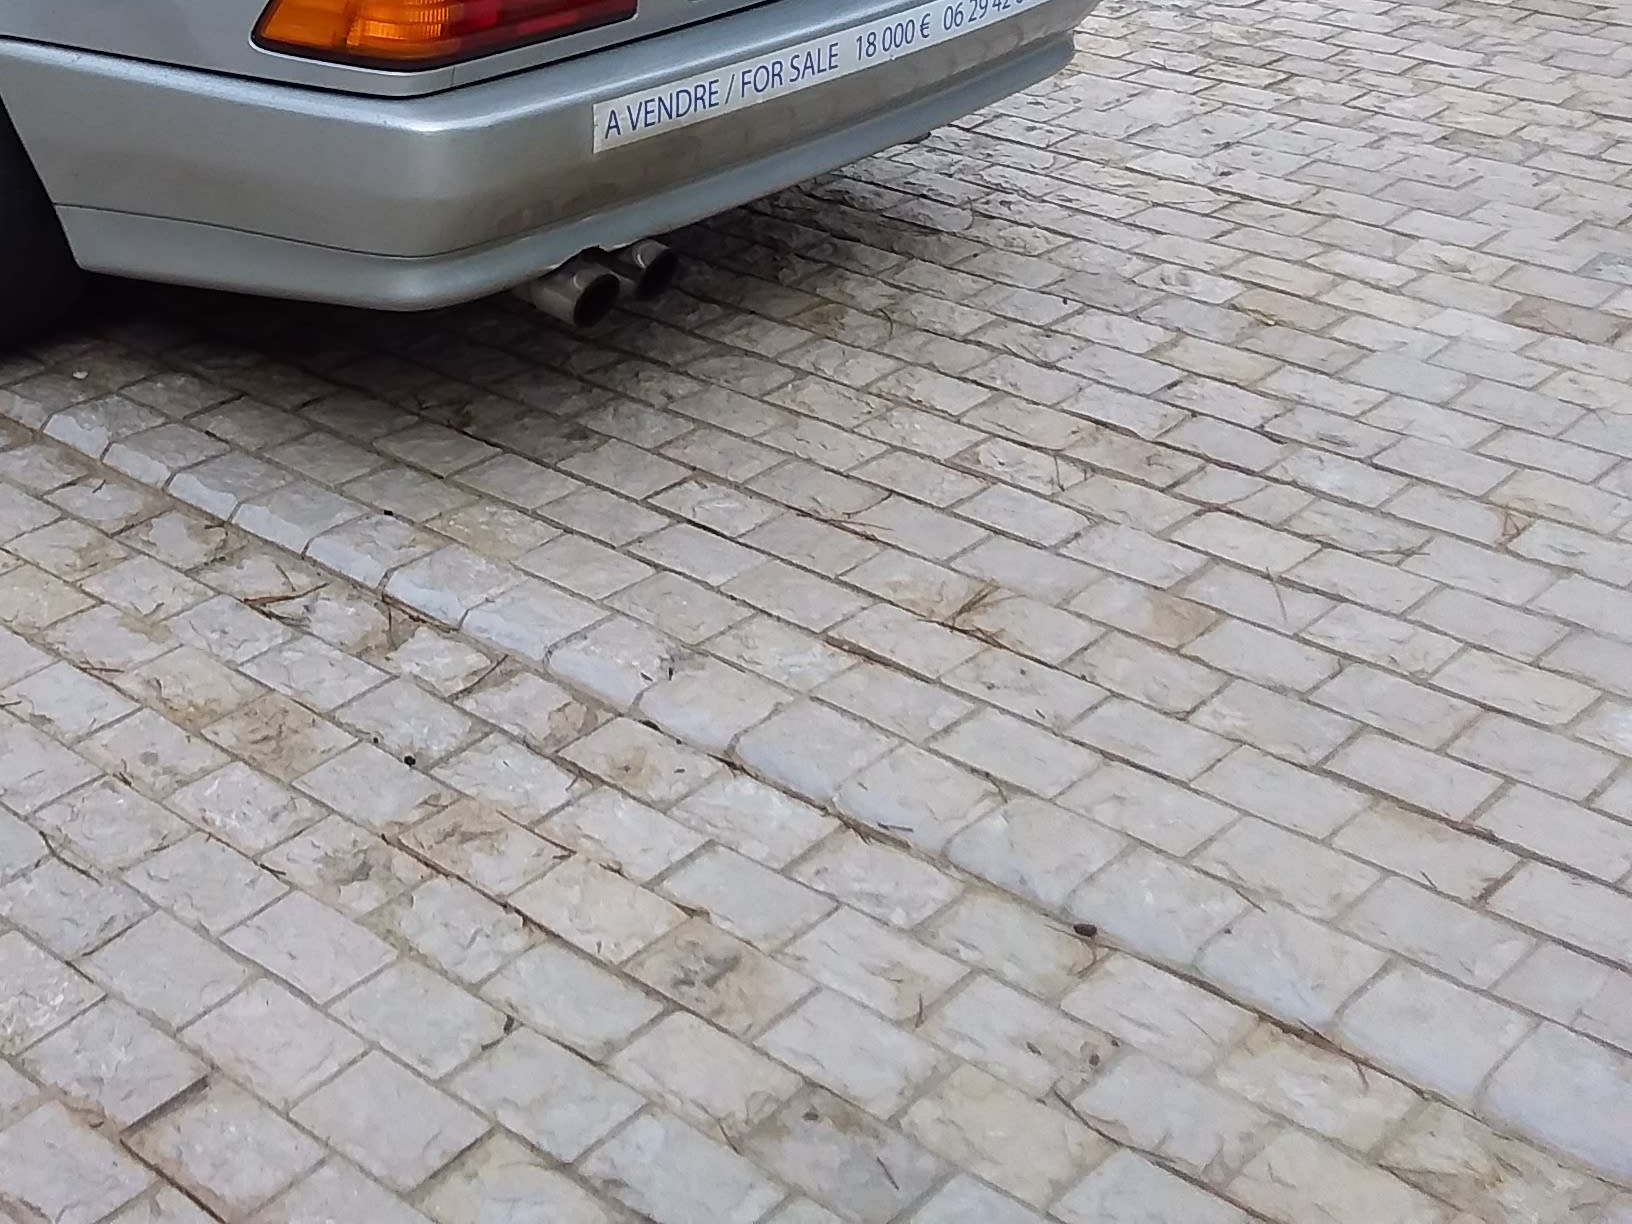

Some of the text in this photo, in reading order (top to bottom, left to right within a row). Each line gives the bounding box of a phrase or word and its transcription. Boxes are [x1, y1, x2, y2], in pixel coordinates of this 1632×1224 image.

[604, 109, 622, 139] A
[626, 78, 720, 132] VENDRE
[724, 73, 736, 105] /
[741, 59, 784, 98] FOR
[789, 41, 840, 83] SALE
[856, 31, 877, 61] 18
[882, 18, 916, 52] 000
[919, 12, 931, 38] €
[943, 1, 964, 30] 06
